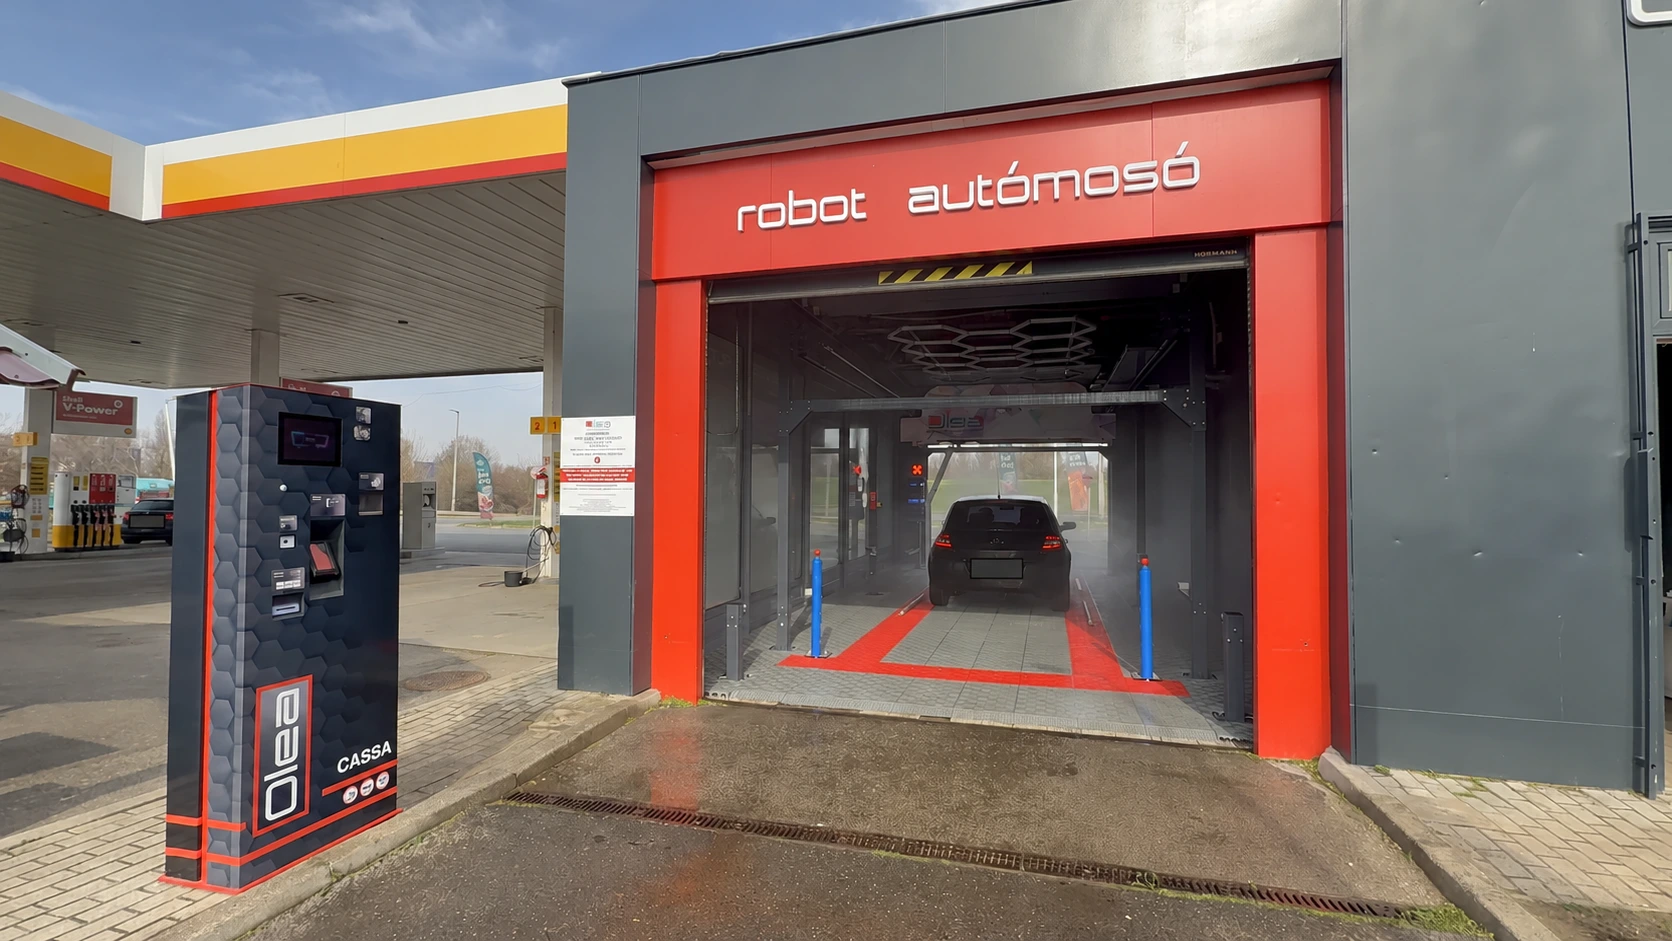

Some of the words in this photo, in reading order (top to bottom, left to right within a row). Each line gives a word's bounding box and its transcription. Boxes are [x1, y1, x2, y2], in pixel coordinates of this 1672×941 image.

[738, 188, 868, 232] robot
[907, 140, 1201, 214] autómosó
[62, 402, 118, 415] V-Power
[534, 421, 541, 431] 2
[552, 421, 557, 430] 1
[337, 741, 392, 773] CASSA
